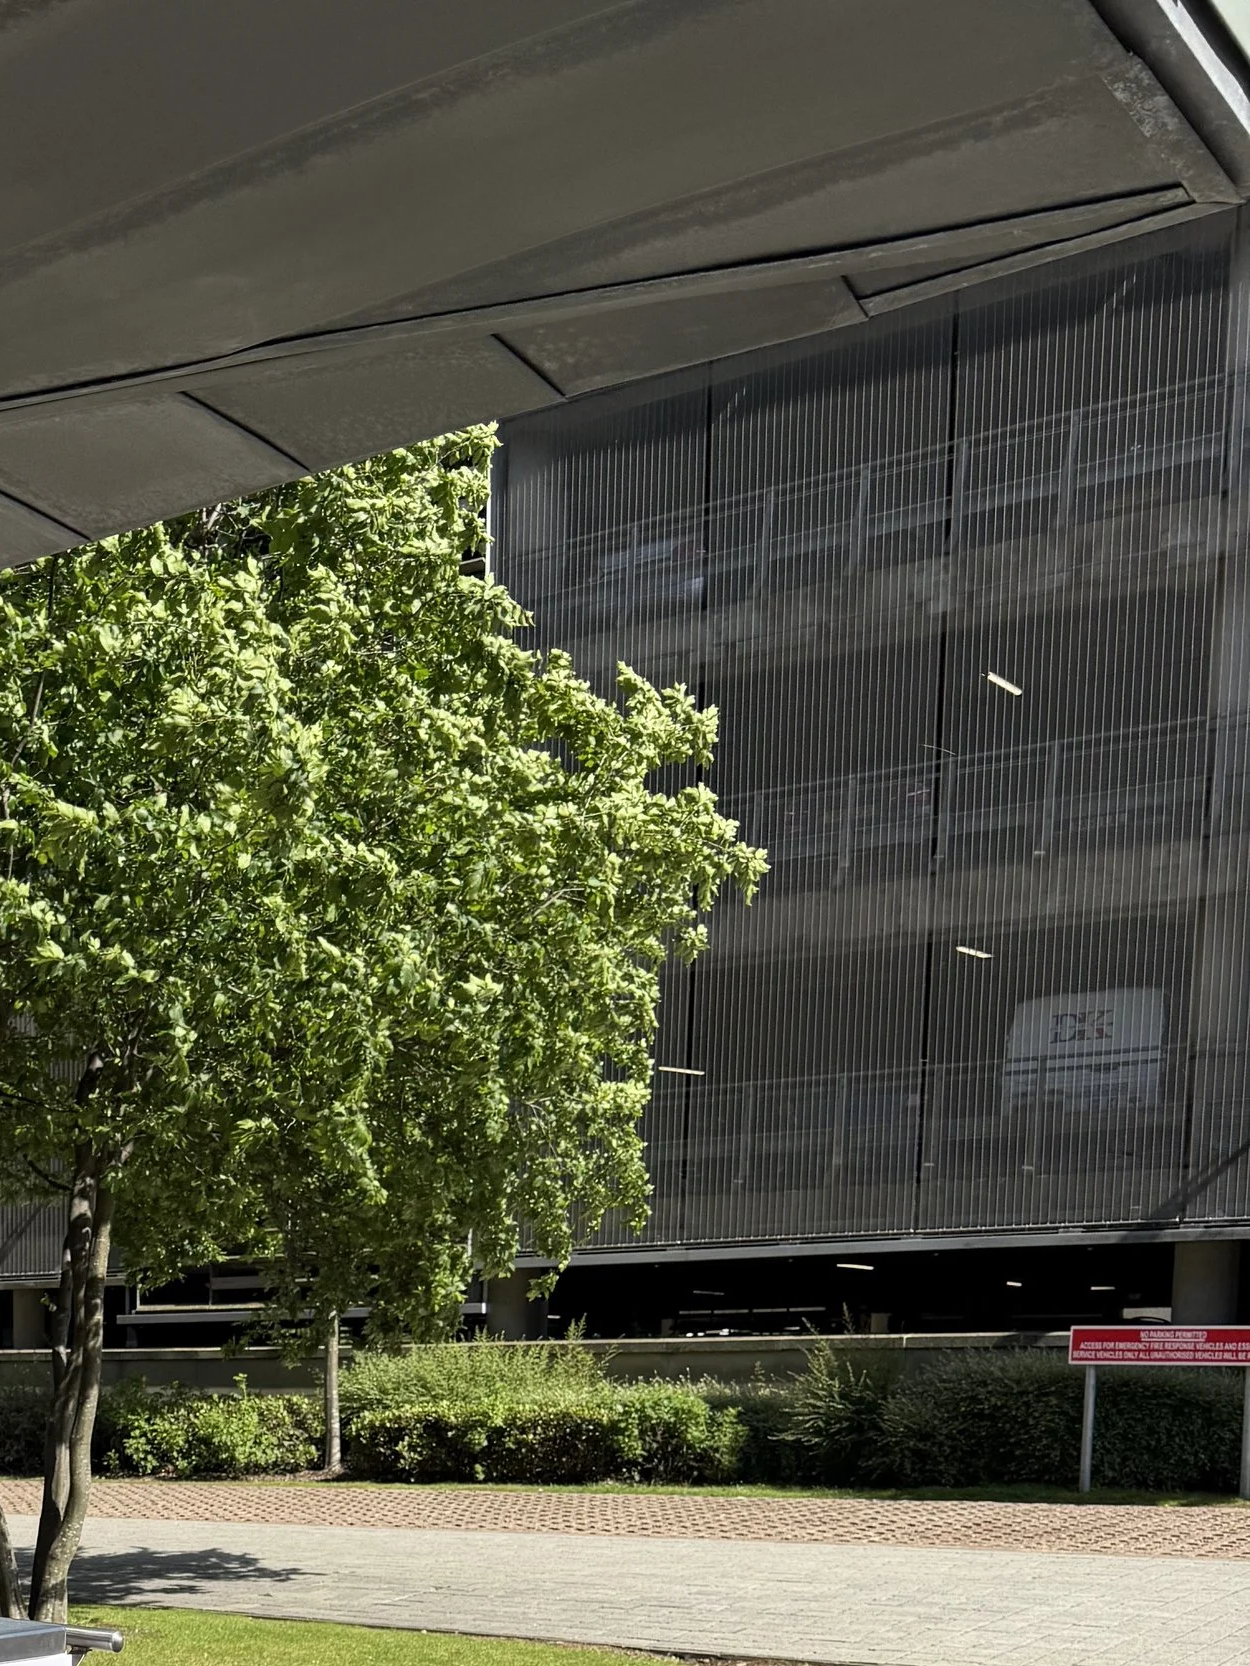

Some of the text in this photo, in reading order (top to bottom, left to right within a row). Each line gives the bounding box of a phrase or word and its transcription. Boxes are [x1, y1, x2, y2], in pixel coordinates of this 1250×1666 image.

[1140, 1330, 1207, 1339] NO PARKING PERMITTED
[1080, 1341, 1102, 1350] ACCESS
[1103, 1341, 1114, 1350] FOR
[1115, 1341, 1149, 1350] EMERGENCY
[1150, 1342, 1163, 1350] FIRE
[1165, 1342, 1194, 1350] RESPONSE
[1195, 1342, 1223, 1350] VEHICLES
[1224, 1342, 1237, 1350] AND
[1073, 1351, 1095, 1359] SERVICE
[1096, 1351, 1123, 1359] VEHICLES
[1123, 1351, 1136, 1359] ONLY
[1137, 1351, 1149, 1359] ALL
[1195, 1351, 1222, 1359] VEHICLES
[1223, 1351, 1237, 1360] WILL
[1238, 1352, 1246, 1360] BE
